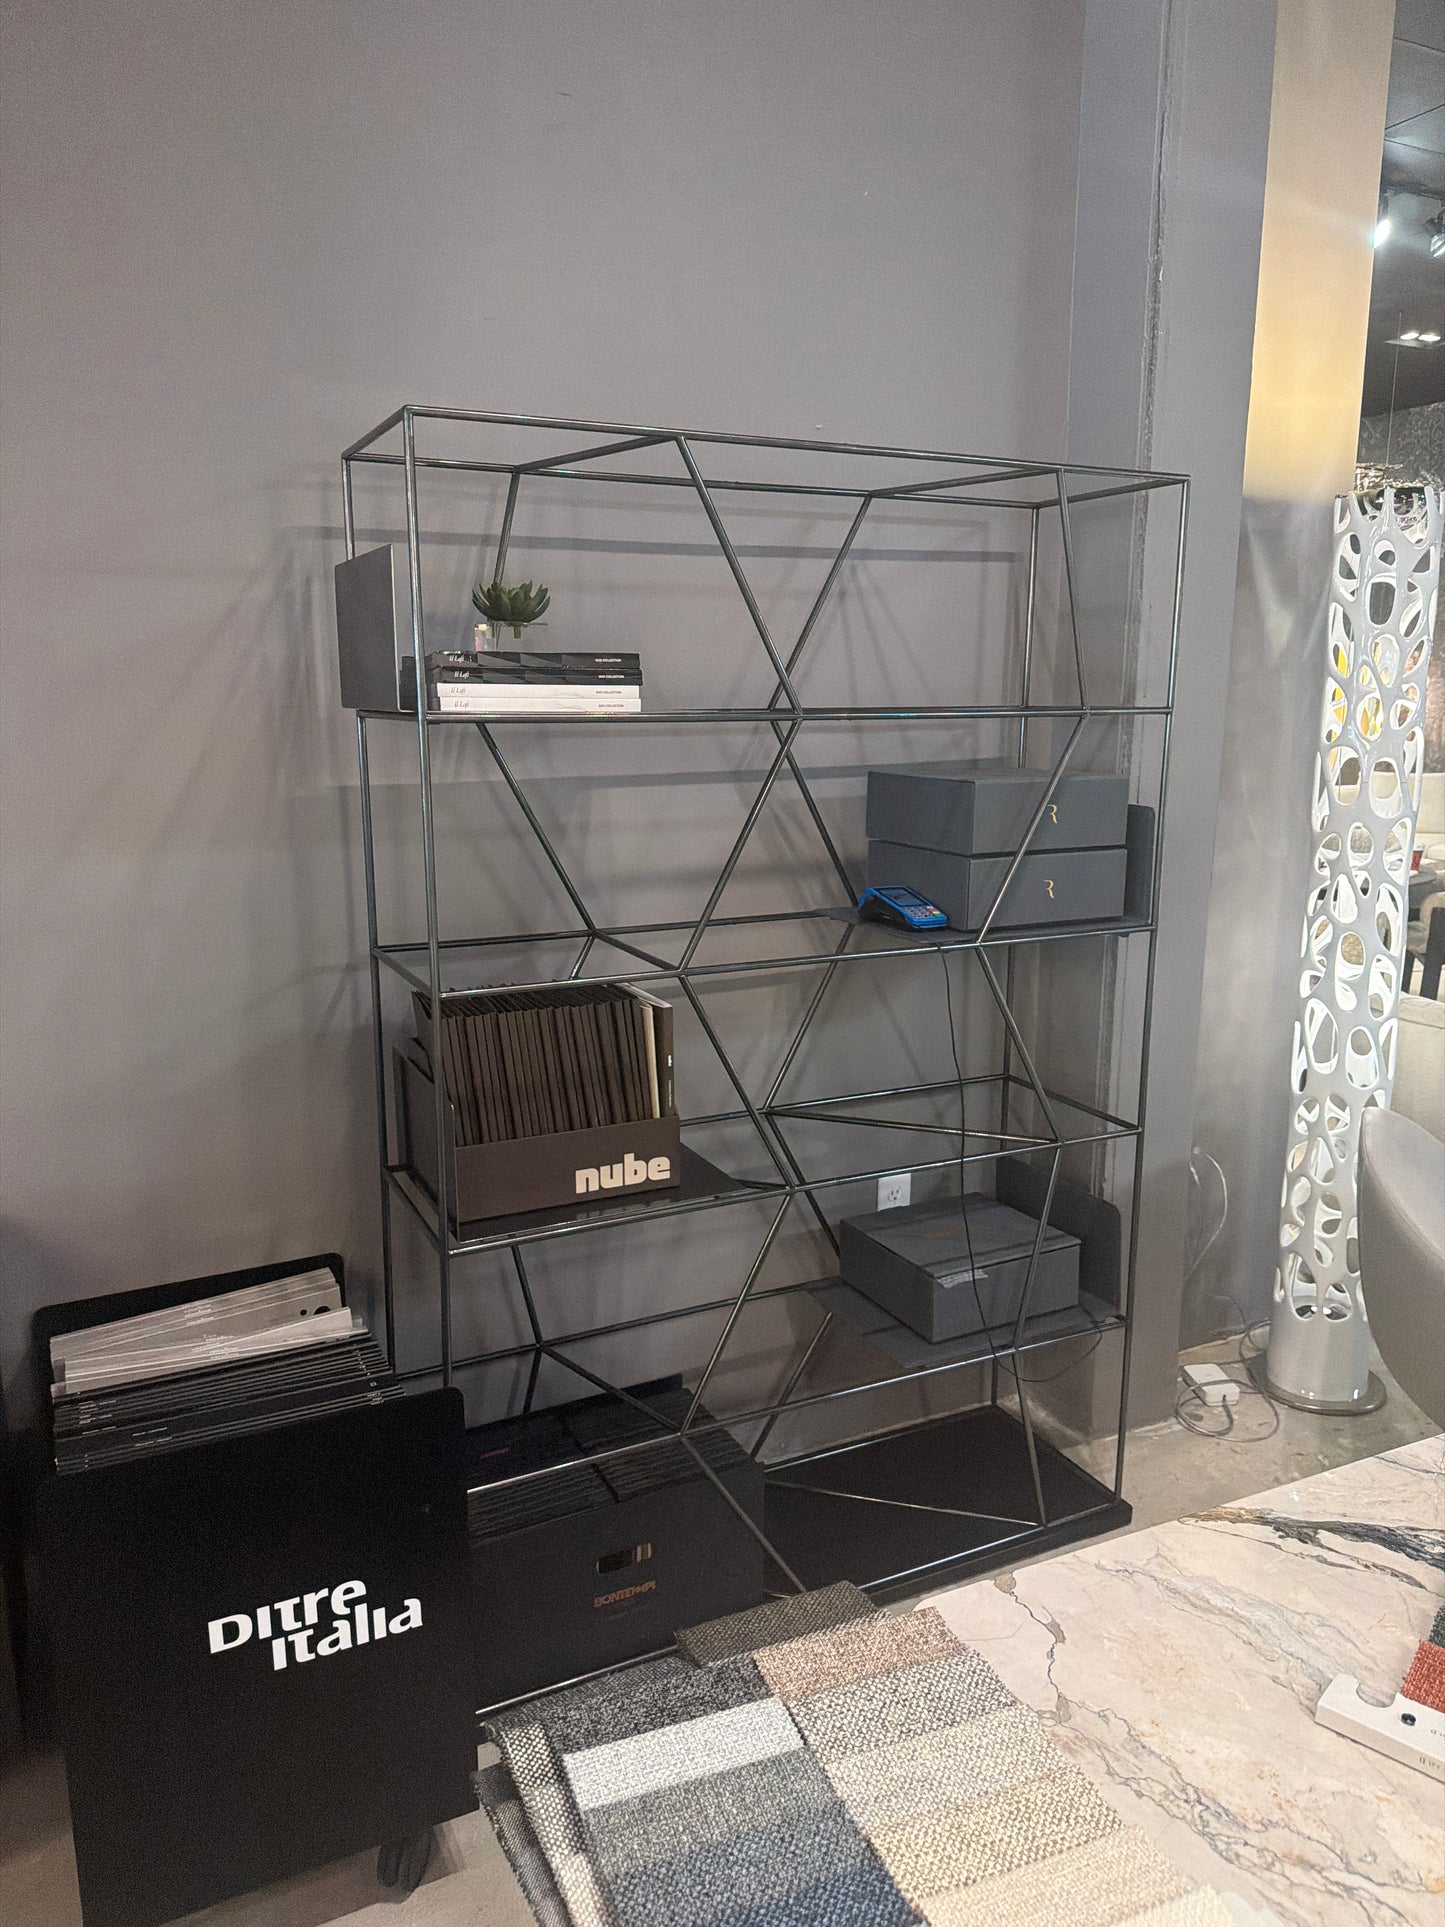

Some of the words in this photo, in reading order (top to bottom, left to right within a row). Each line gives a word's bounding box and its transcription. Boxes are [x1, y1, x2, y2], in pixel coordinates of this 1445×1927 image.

[575, 1152, 671, 1194] nube
[207, 1580, 367, 1654] Ditre
[271, 1598, 423, 1671] Italia
